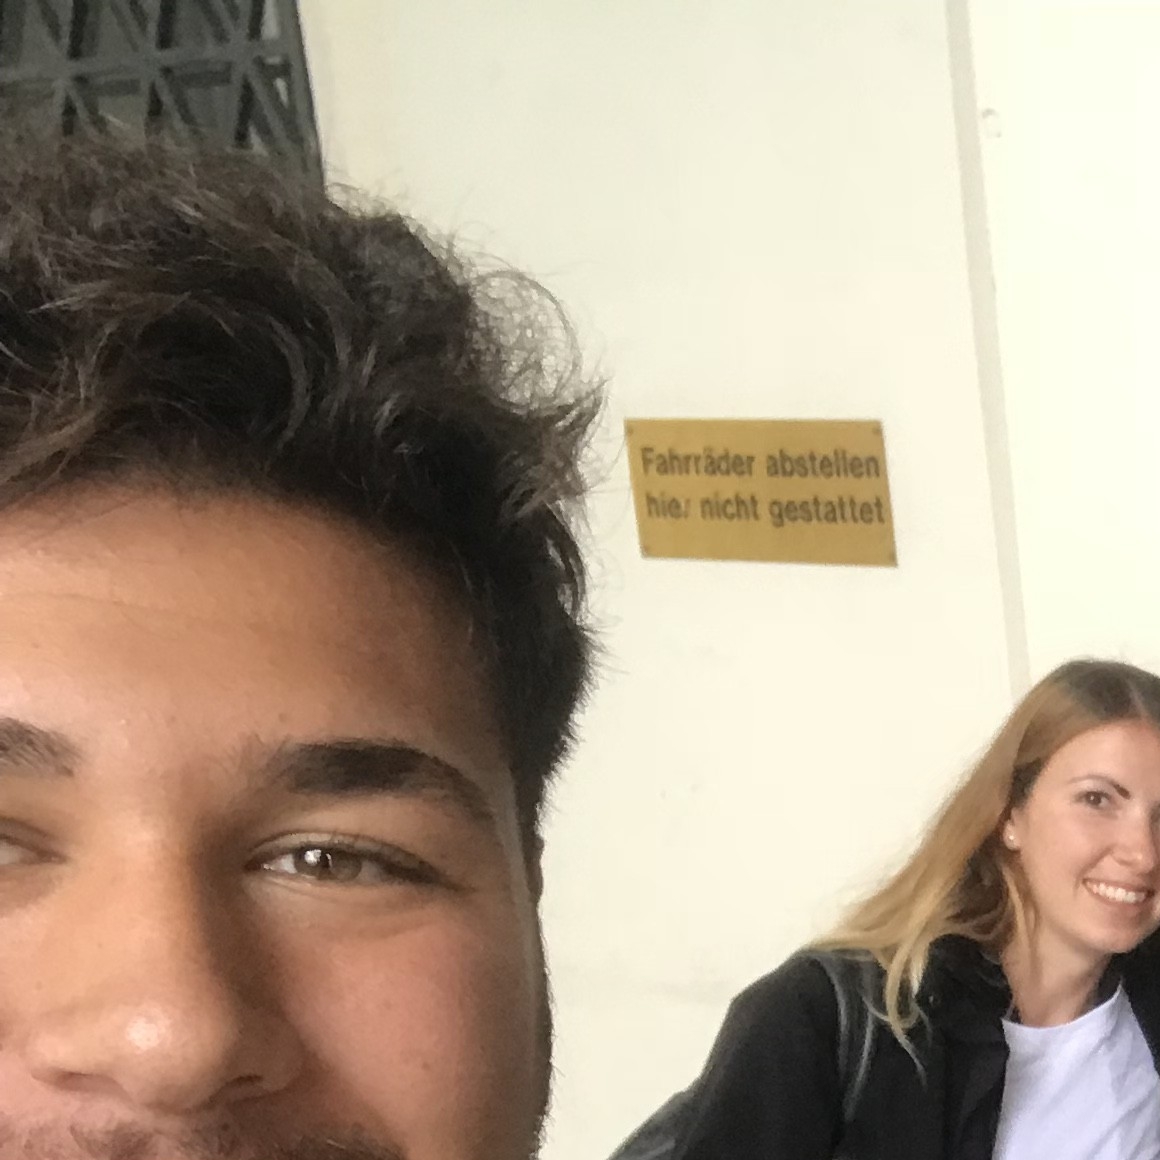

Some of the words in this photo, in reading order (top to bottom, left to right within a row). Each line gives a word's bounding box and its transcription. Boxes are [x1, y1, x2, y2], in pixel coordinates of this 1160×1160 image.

[640, 446, 755, 477] Fahrräder
[766, 448, 880, 479] abstellen
[700, 492, 760, 522] nicht
[768, 495, 886, 528] gestattet
